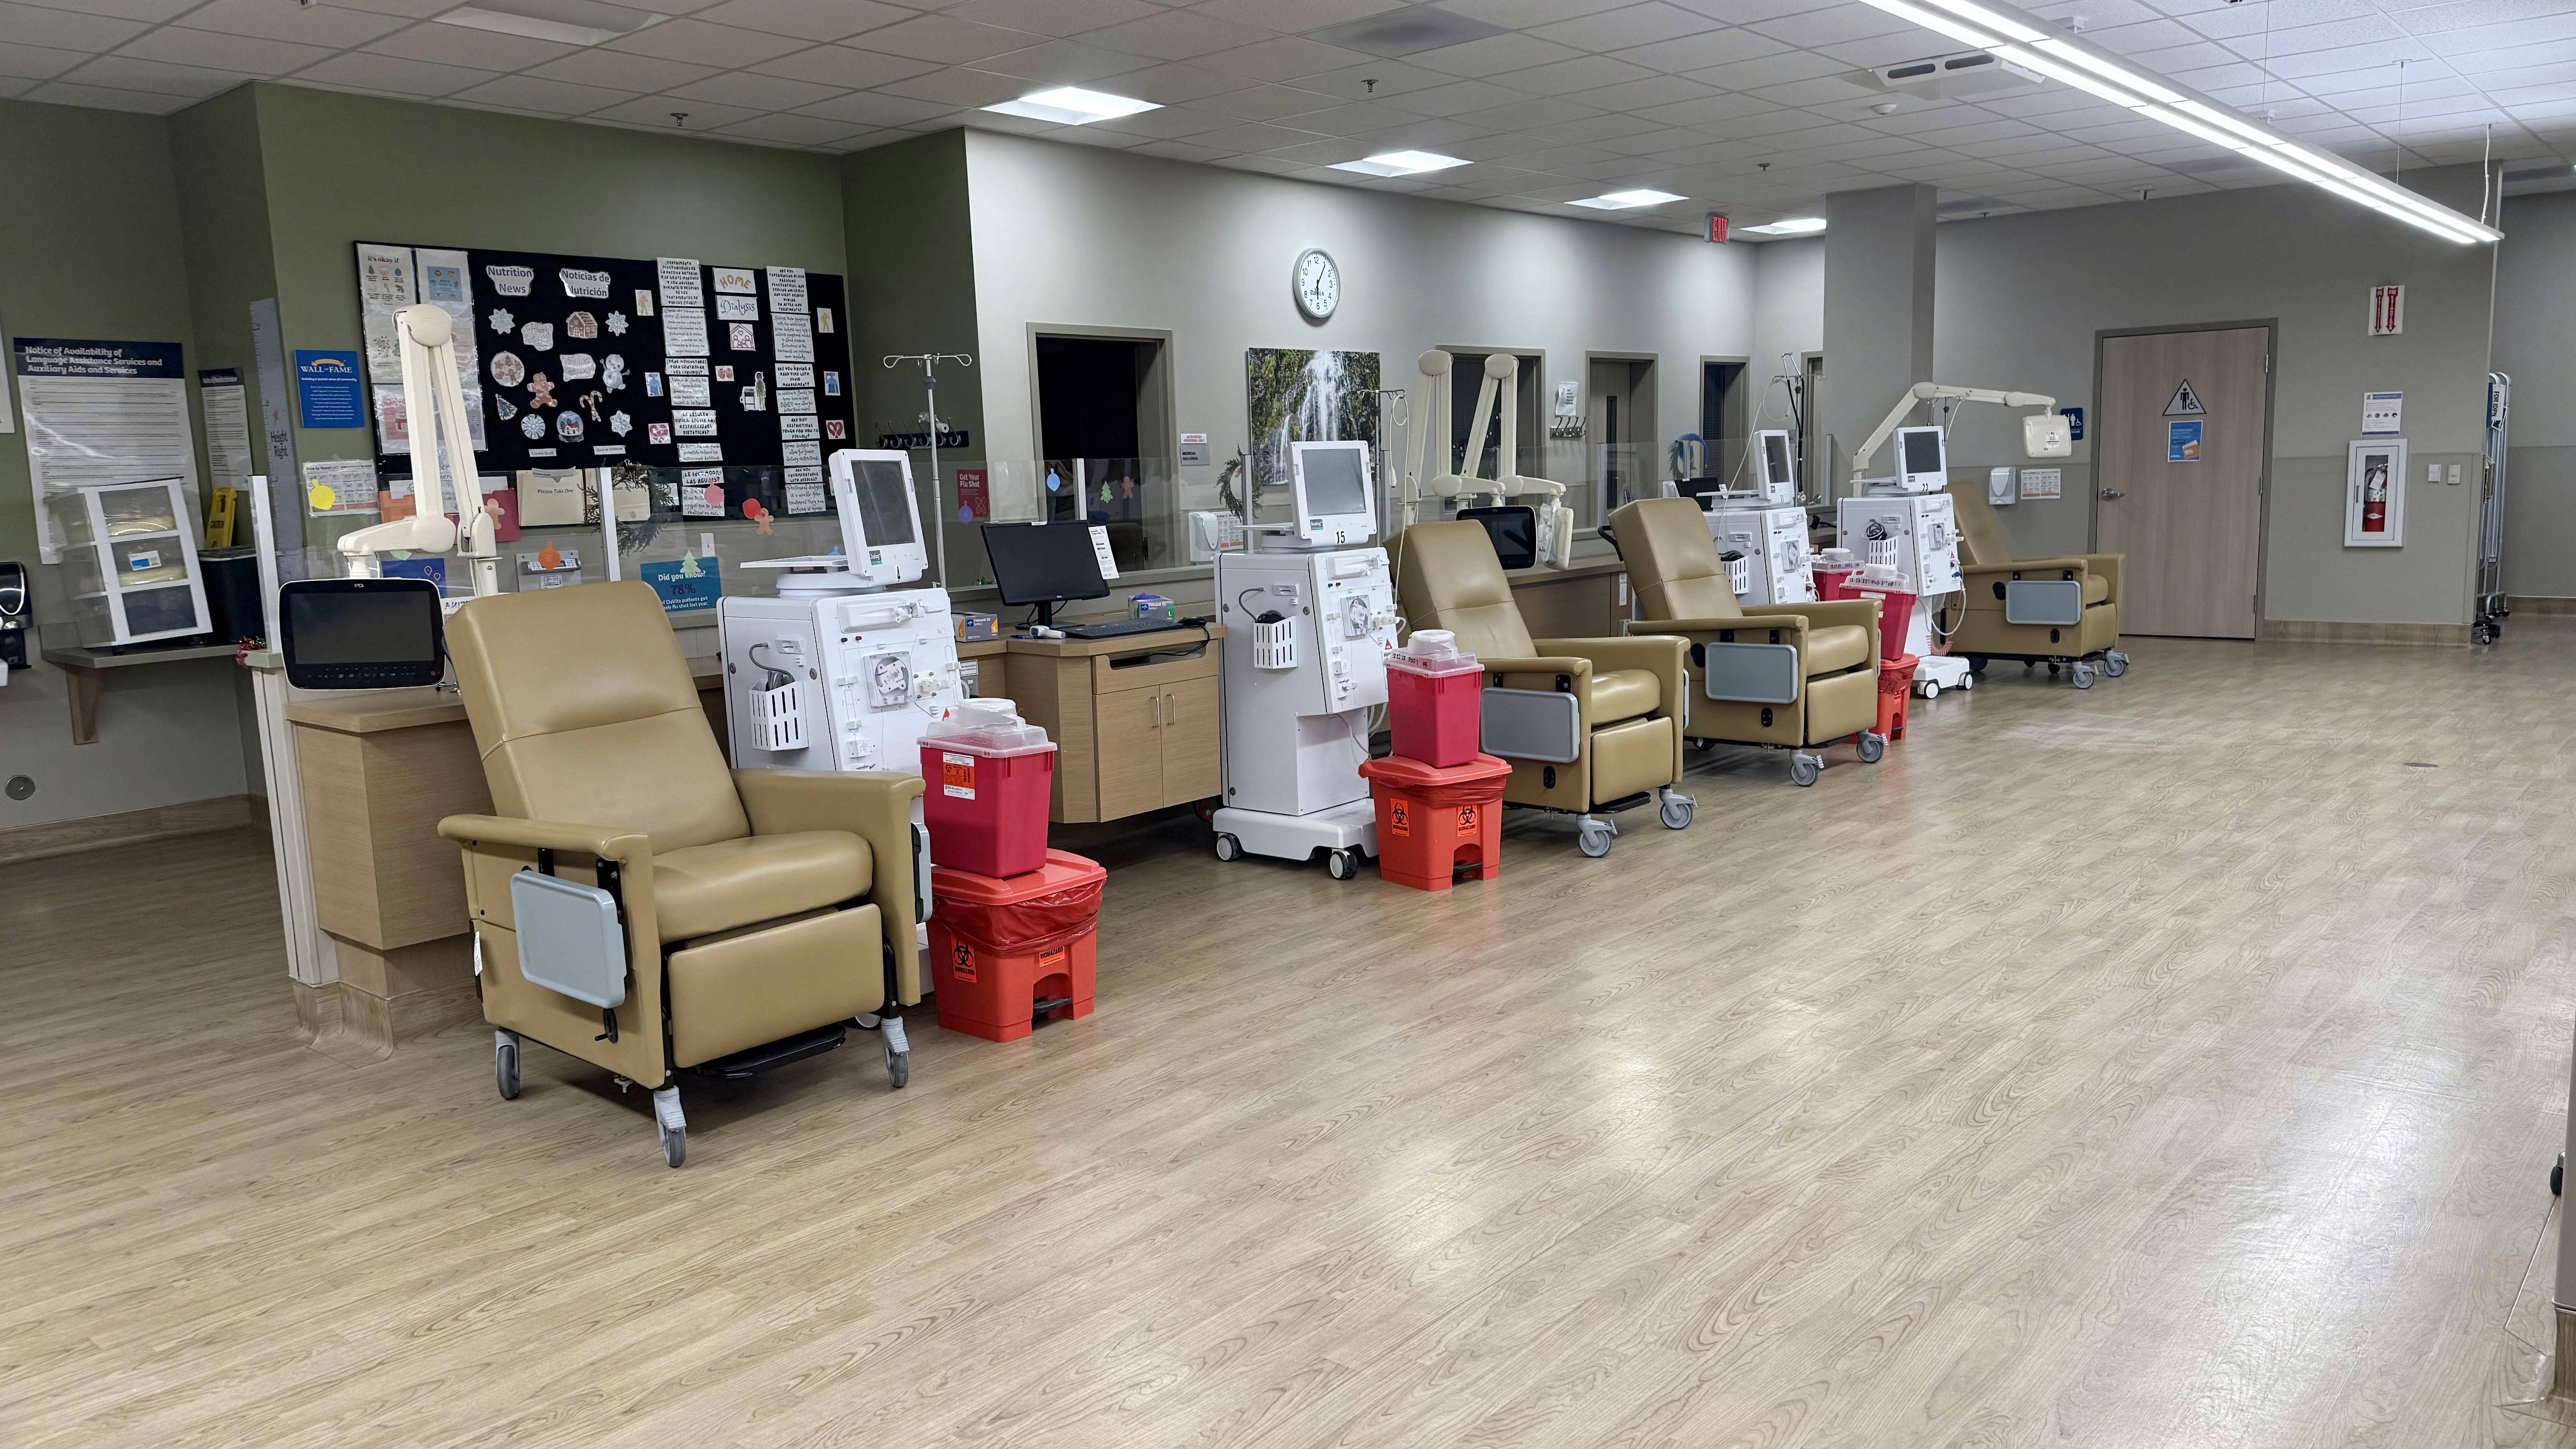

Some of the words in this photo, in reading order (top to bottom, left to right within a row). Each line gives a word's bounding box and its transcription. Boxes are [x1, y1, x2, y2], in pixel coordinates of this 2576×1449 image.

[1712, 216, 1728, 242] EXIT
[488, 267, 532, 278] Nutrition
[562, 271, 597, 281] Noticias
[599, 274, 609, 282] de
[720, 274, 751, 289] HOME
[499, 284, 526, 293] News
[721, 299, 755, 315] Dialysis
[54, 347, 63, 355] of
[64, 348, 112, 357] Availability
[114, 349, 122, 357] of
[26, 356, 68, 366] Language
[28, 365, 67, 374] Auxiliary
[271, 430, 288, 445] Height
[274, 446, 288, 460] Right
[1922, 483, 1928, 492] 23
[1336, 531, 1345, 544] 15
[671, 584, 696, 595] 78%
[1040, 947, 1063, 959] BIOHAZARD
